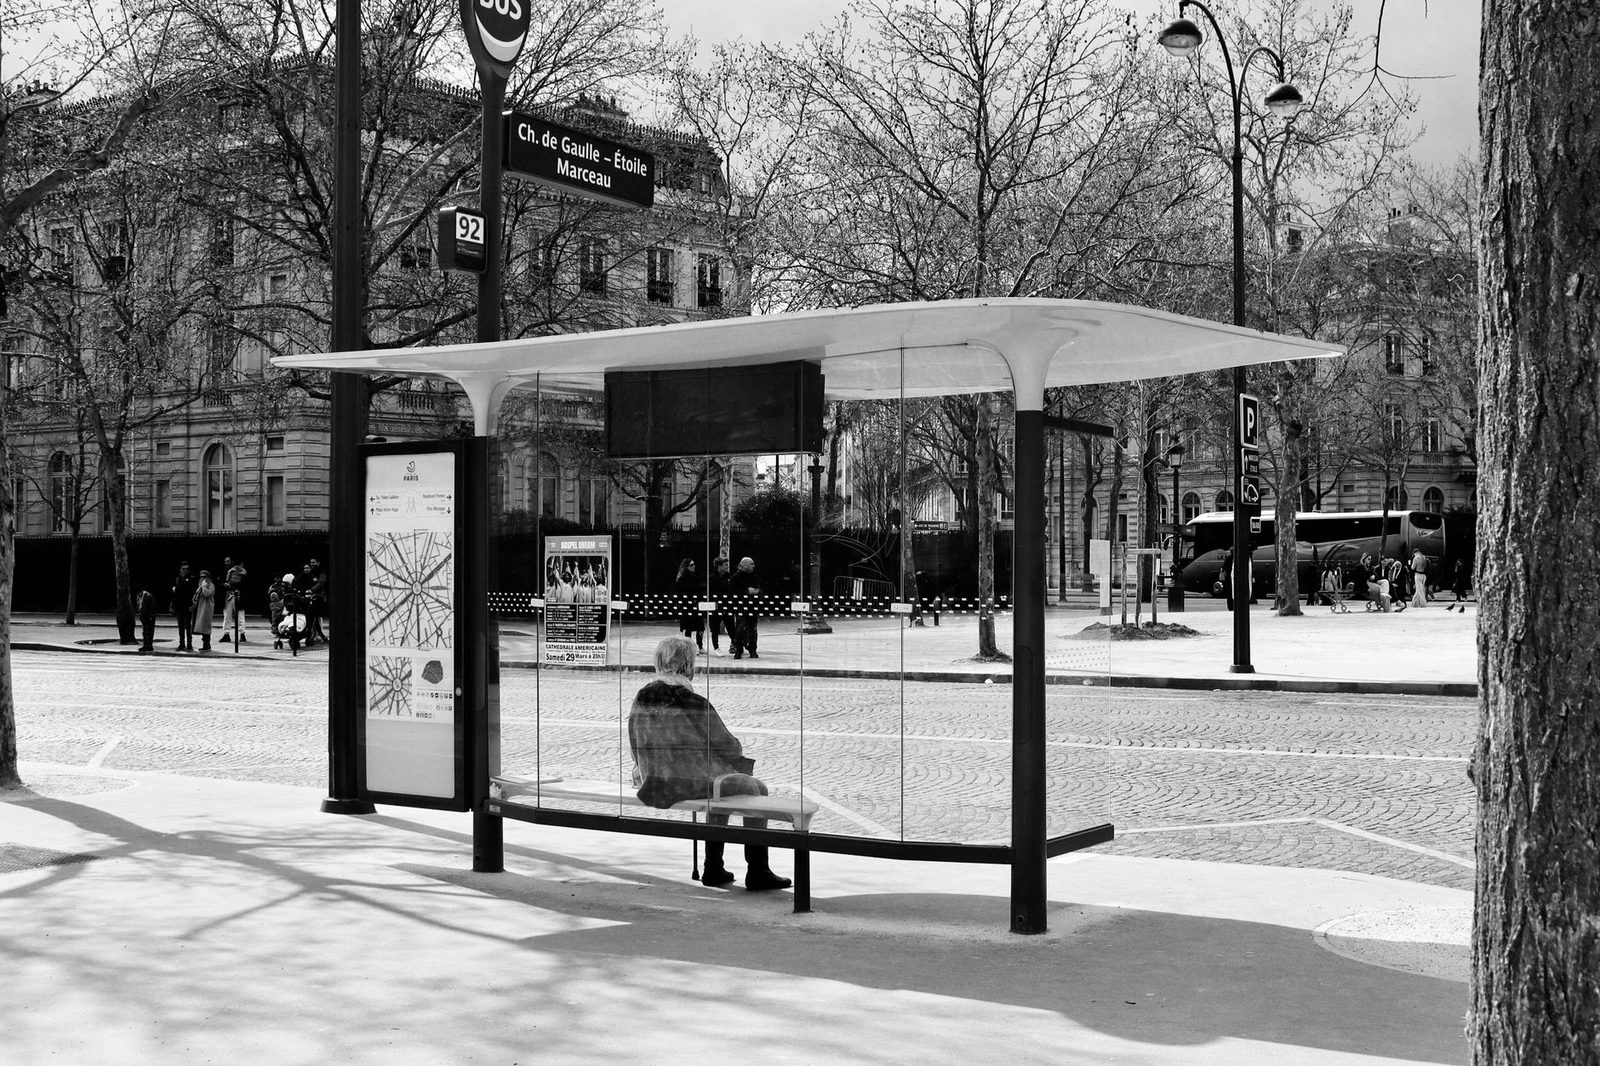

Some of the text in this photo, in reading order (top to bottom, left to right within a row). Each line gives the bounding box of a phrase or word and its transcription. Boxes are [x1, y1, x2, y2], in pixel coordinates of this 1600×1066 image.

[517, 122, 539, 145] Ch.
[542, 130, 558, 150] de
[561, 136, 600, 163] Gaulle
[614, 149, 648, 177] Étoile
[556, 157, 611, 188] Marceau
[458, 215, 481, 241] 92
[1247, 406, 1255, 437] P
[560, 541, 578, 549] GOSPEL
[545, 653, 565, 661] Samedi
[565, 653, 575, 661] 29
